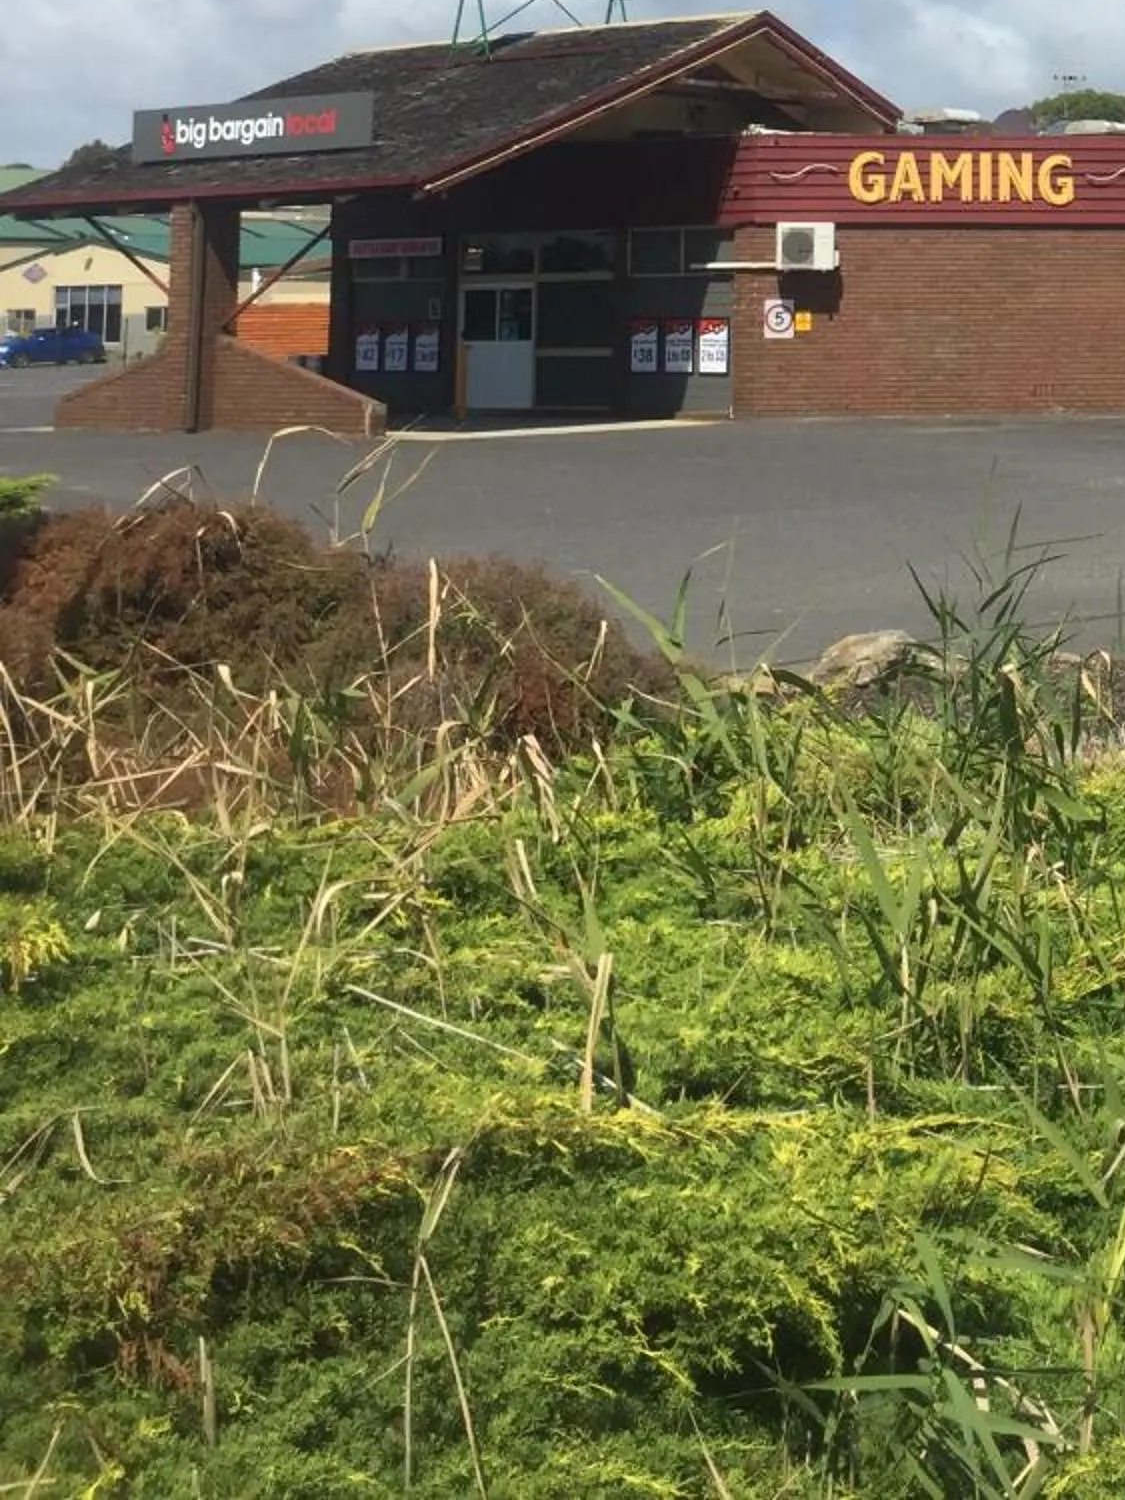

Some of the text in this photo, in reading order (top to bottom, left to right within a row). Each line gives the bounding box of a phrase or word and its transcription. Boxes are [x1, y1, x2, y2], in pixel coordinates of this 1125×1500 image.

[176, 108, 337, 148] big bargain local
[849, 151, 1075, 206] GAMING
[775, 311, 785, 327] 5
